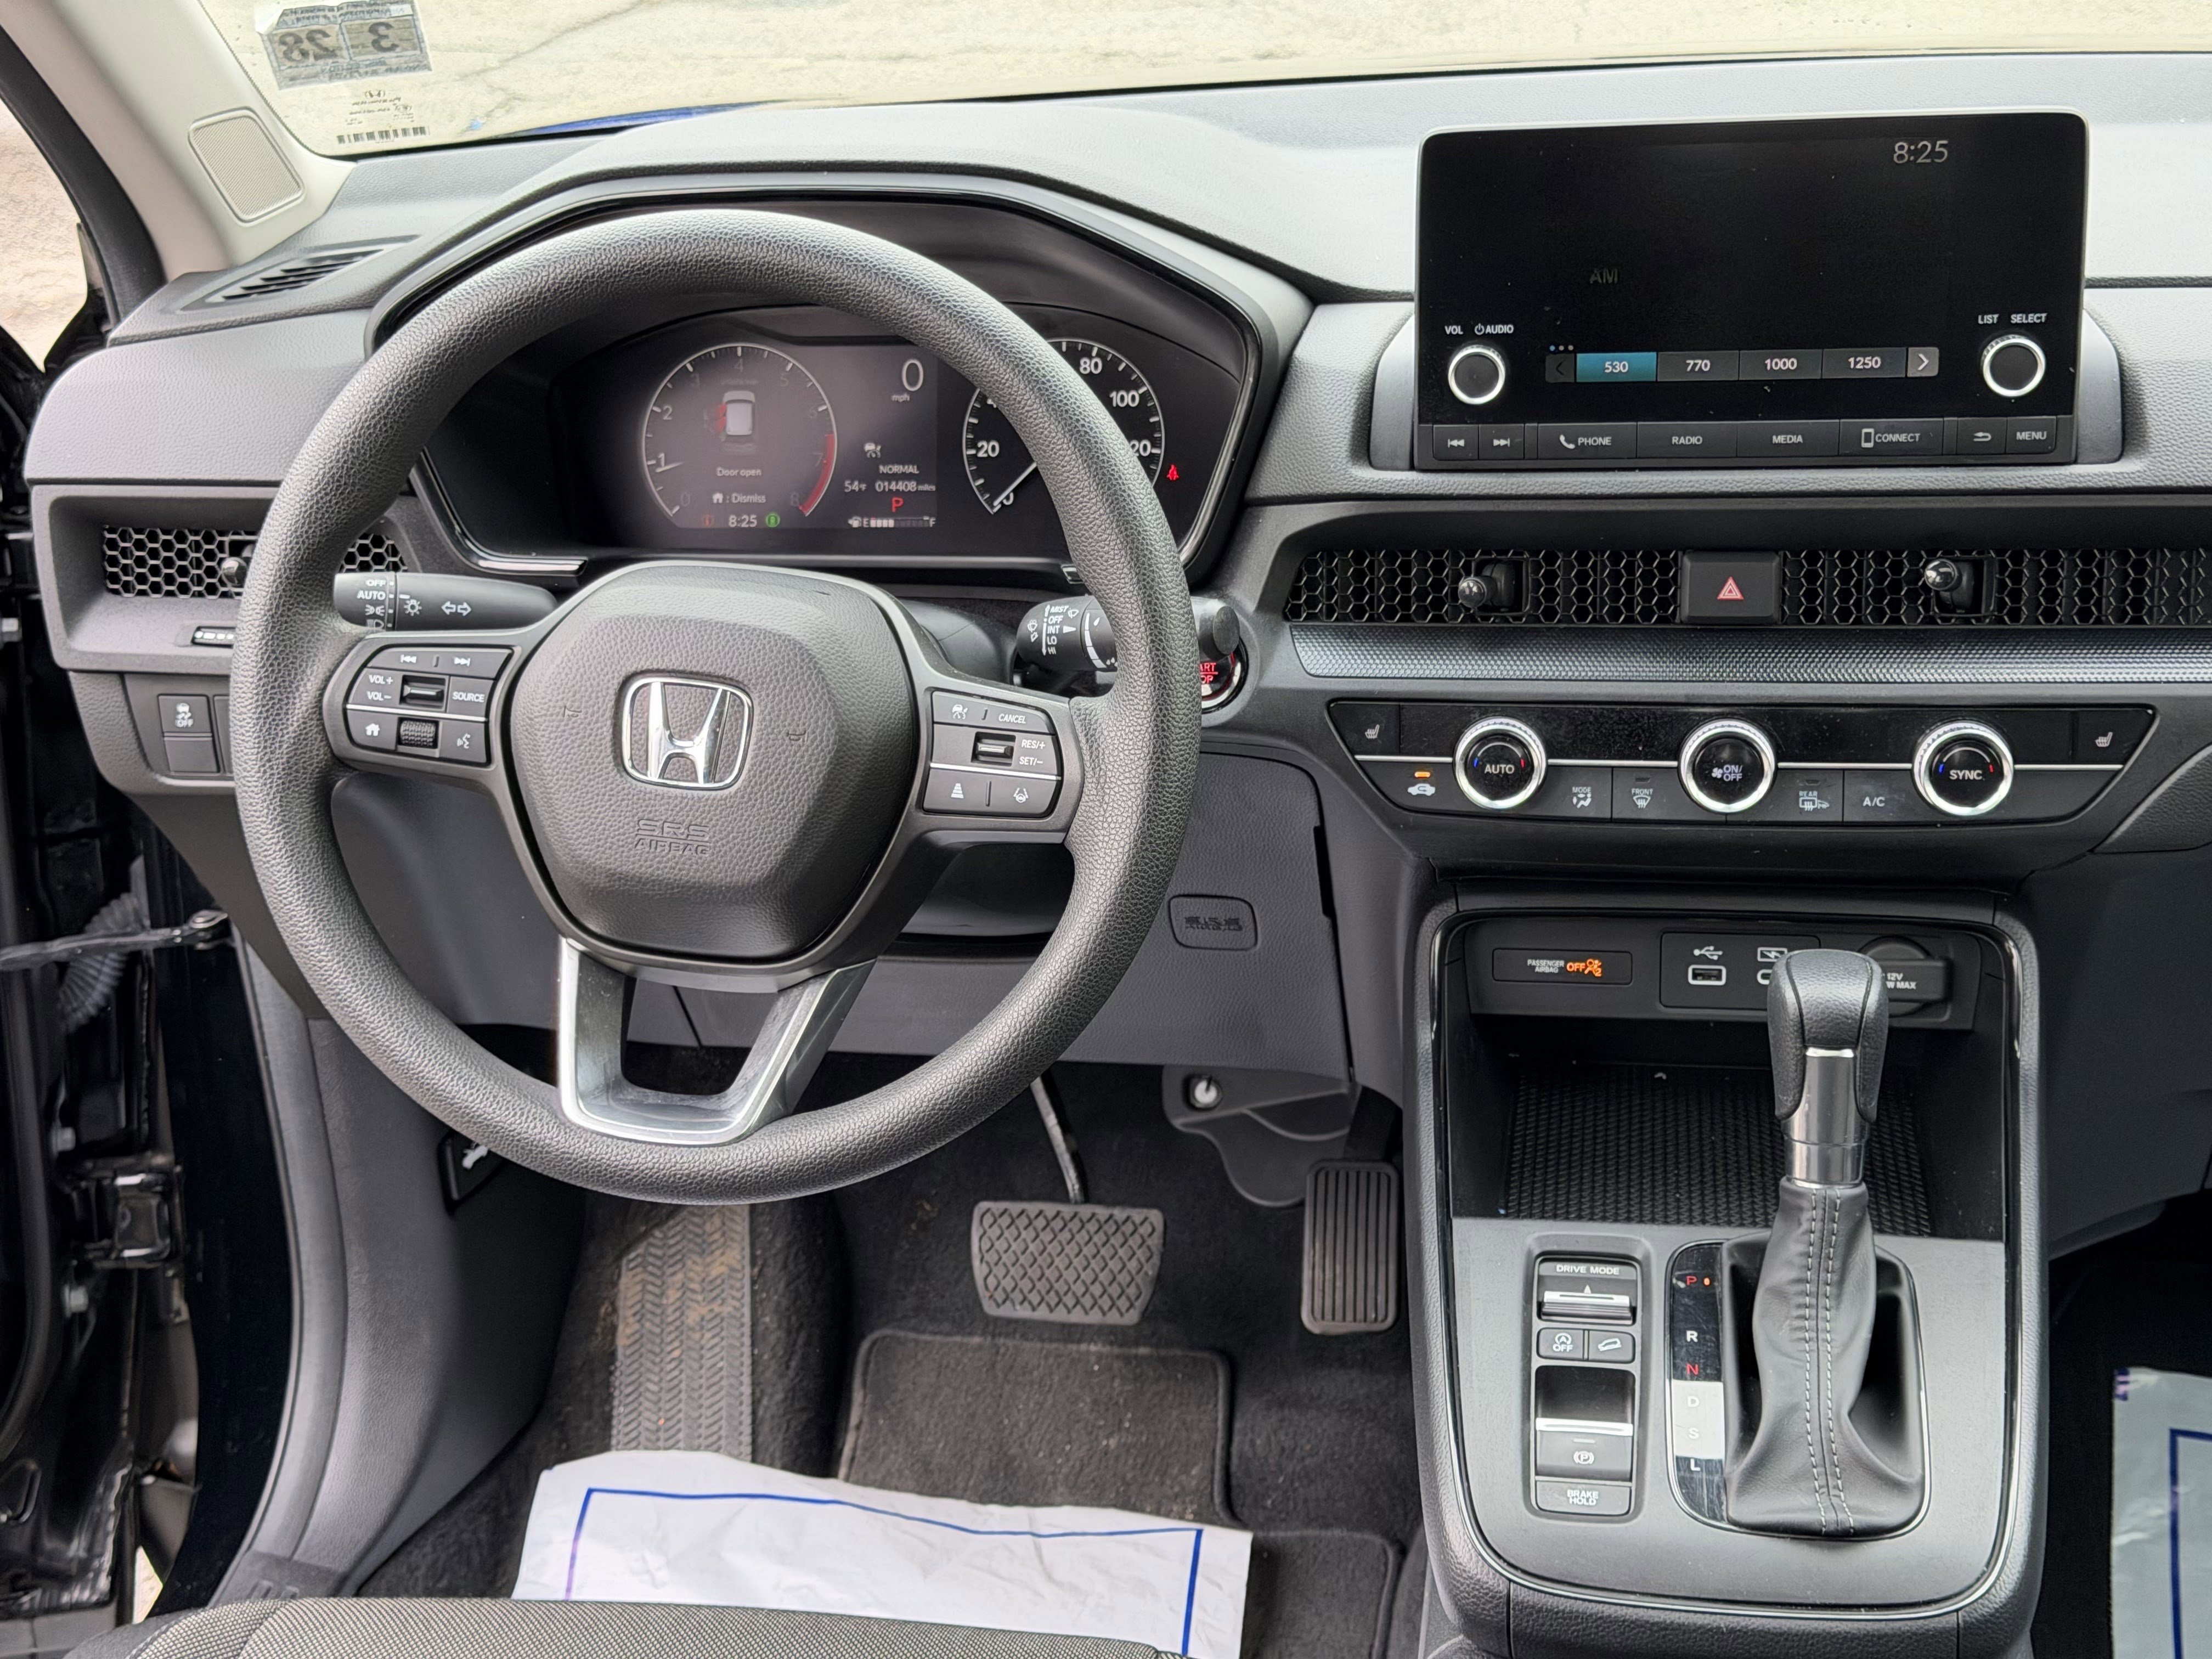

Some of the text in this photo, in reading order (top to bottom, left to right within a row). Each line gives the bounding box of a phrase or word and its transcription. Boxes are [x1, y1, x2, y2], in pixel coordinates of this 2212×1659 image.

[1893, 140, 1948, 163] 8:25
[1978, 313, 2047, 324] LIST SELECT
[1445, 325, 1514, 335] VOL AUDIO
[1079, 358, 1102, 375] 80
[1605, 361, 1628, 373] 530
[1686, 360, 1711, 372] 770
[1765, 358, 1797, 370] 1000
[1848, 357, 1881, 369] 1250
[902, 359, 924, 391] 0
[891, 393, 910, 403] mph
[1109, 390, 1139, 408] 100
[663, 405, 673, 420] 2
[1672, 436, 1703, 445] RADIO
[1773, 435, 1803, 445] MEDIA
[1875, 433, 1920, 443] CONNECT
[2016, 431, 2047, 441] MENU
[1578, 436, 1612, 447] PHONE
[977, 440, 1000, 458] 20
[1131, 440, 1151, 457] 20
[659, 453, 665, 466] 1
[716, 467, 762, 477] Door open
[879, 464, 919, 474] NORMAL
[874, 480, 917, 492] 014408
[731, 493, 766, 503] Dismiss
[891, 496, 904, 513] P
[728, 514, 757, 527] 8:25
[365, 579, 386, 587] OFF
[357, 590, 386, 600] AUTO
[1049, 605, 1070, 613] MIST
[1048, 615, 1064, 624] OFF
[1047, 625, 1060, 634] INT
[1047, 635, 1057, 645] LO
[1047, 646, 1057, 655] HI
[369, 674, 393, 684] VOL+
[452, 691, 485, 702] SOURCE
[998, 713, 1026, 724] CANCEL
[1021, 738, 1046, 749] RES/+
[1484, 764, 1515, 775] AUTO
[1723, 764, 1743, 773] ON/
[1723, 773, 1743, 781] OFF
[1949, 770, 1983, 780] SYNC
[1863, 797, 1886, 807] A/C
[637, 818, 712, 840] SRS
[1527, 959, 1564, 967] PASSENGER
[1566, 962, 1585, 972] OFF
[1886, 981, 1917, 990] W MAX
[1556, 1265, 1620, 1275] DRIVE MODE
[1686, 1276, 1697, 1285] P
[1686, 1330, 1698, 1342] R
[1553, 1344, 1573, 1352] OFF
[1686, 1363, 1699, 1375] N
[1688, 1396, 1700, 1408] D
[1688, 1427, 1700, 1440] S
[1690, 1458, 1701, 1471] L
[1567, 1489, 1599, 1499] BRAKE
[1569, 1497, 1597, 1506] HOLD
